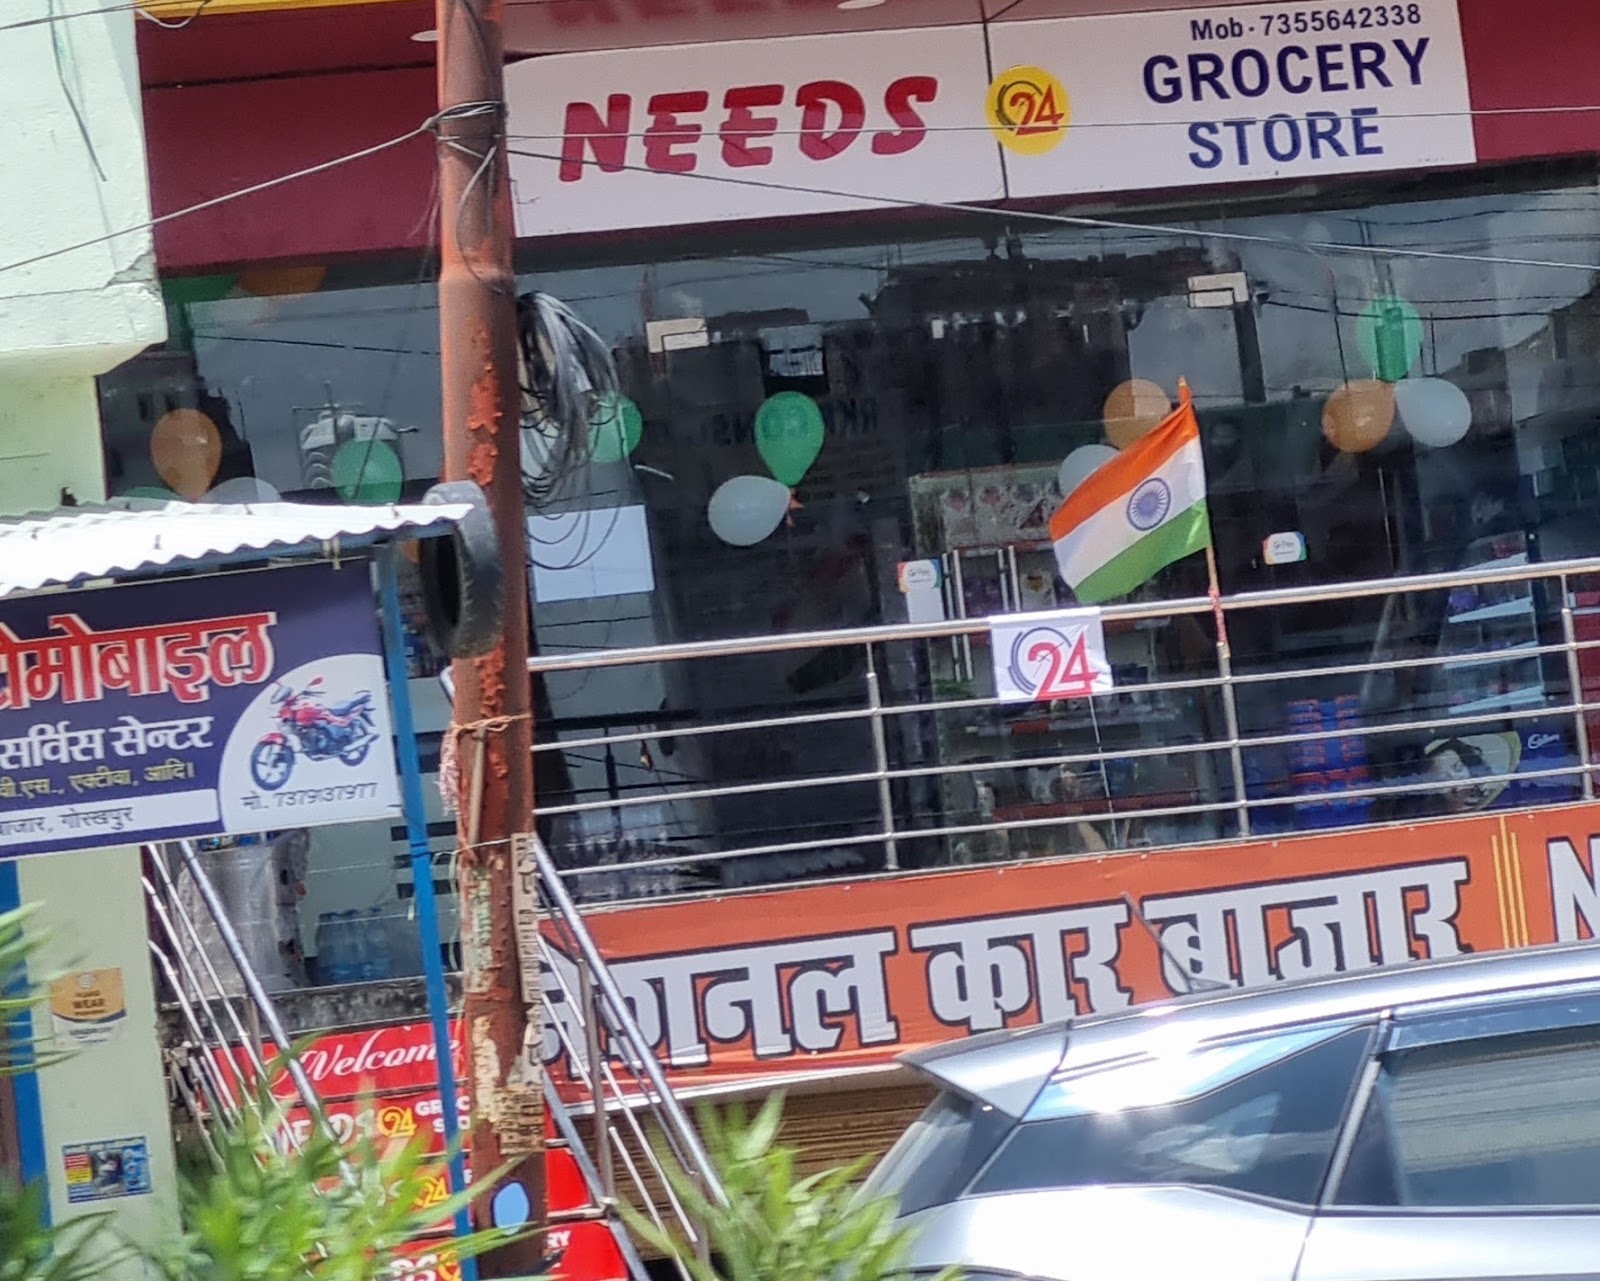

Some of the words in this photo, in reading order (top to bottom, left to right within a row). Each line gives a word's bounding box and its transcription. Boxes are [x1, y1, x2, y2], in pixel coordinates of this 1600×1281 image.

[1143, 37, 1430, 104] GROCERY
[558, 76, 938, 182] NEEDS
[1009, 84, 1064, 136] 24
[1188, 108, 1384, 170] STORE
[0, 612, 277, 710] ोमोबाइल
[1027, 631, 1100, 700] 24
[0, 721, 105, 770] सर्विस
[109, 715, 215, 756] सेन्टर
[908, 903, 1132, 1032] कार
[1141, 856, 1475, 995] बाजार
